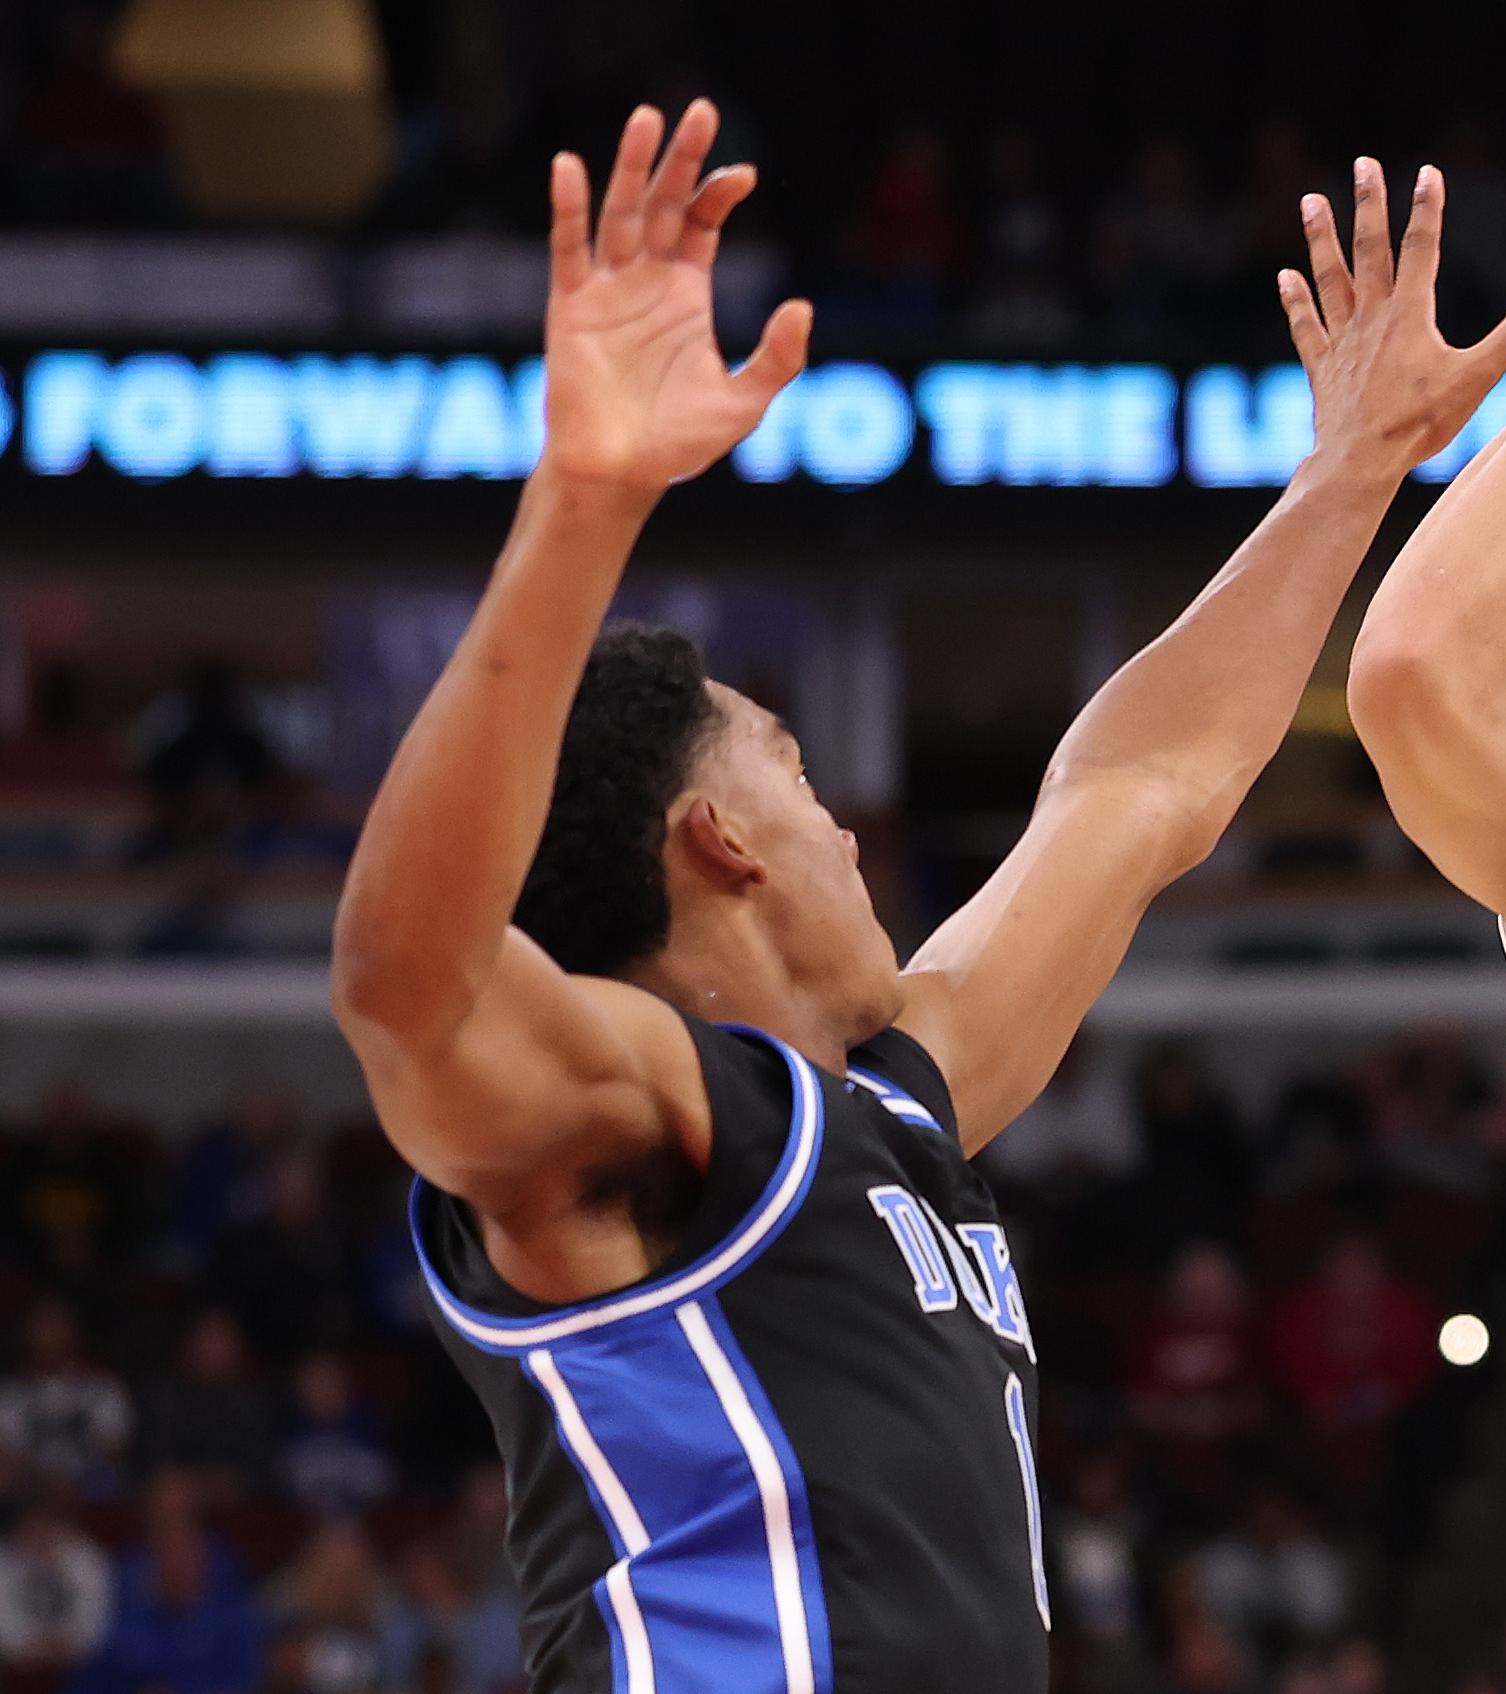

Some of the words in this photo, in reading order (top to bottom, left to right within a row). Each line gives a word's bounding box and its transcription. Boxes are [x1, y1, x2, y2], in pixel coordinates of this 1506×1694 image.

[24, 350, 546, 480] FORWA
[914, 362, 1180, 487] THE
[867, 1184, 1037, 1366] DUK
